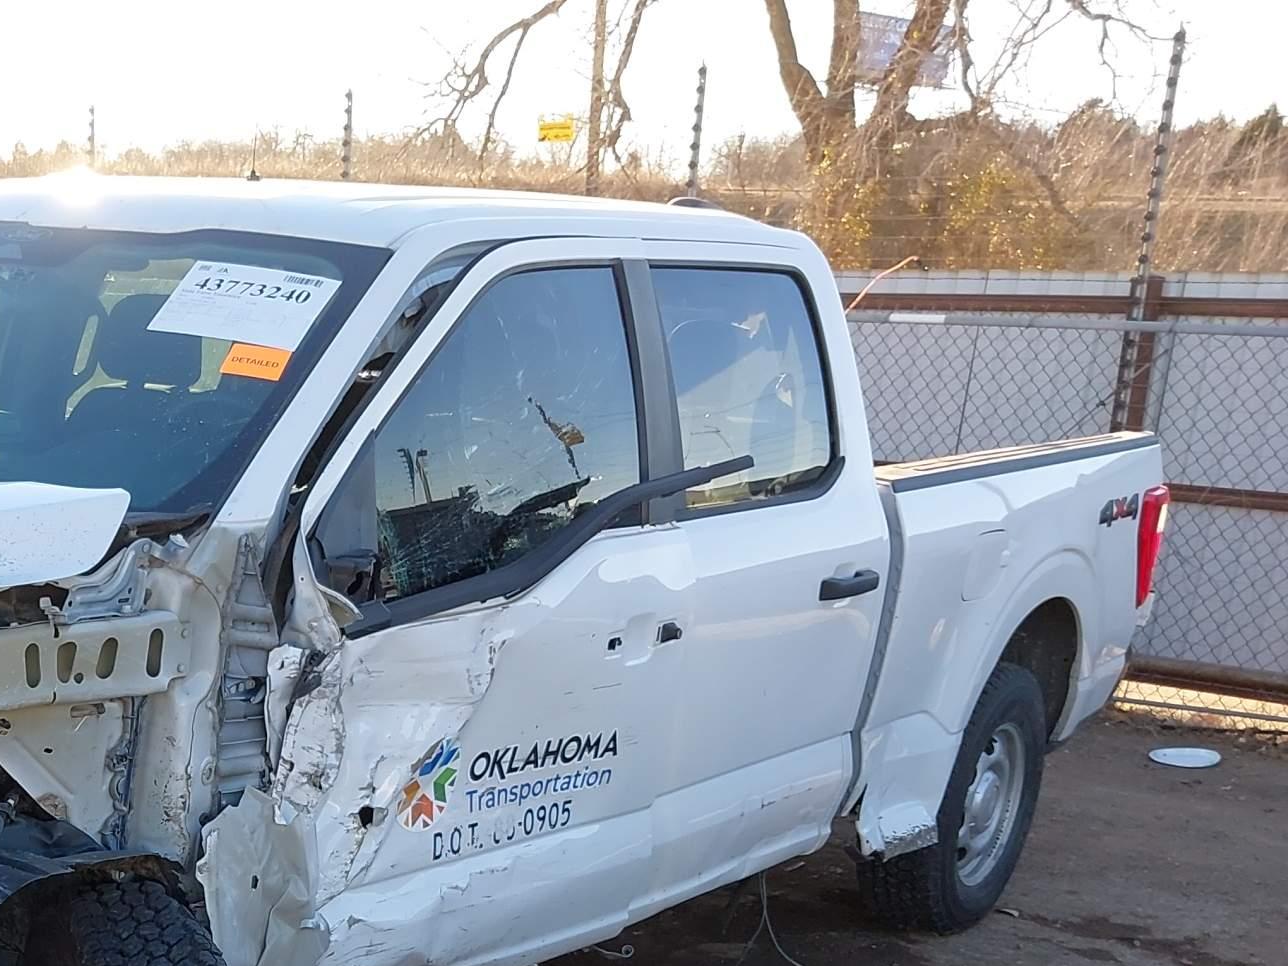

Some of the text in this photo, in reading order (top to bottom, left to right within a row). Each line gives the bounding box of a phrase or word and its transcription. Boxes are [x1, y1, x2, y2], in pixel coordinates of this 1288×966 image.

[195, 276, 312, 304] 43773240
[231, 356, 279, 368] DETAILED
[469, 730, 618, 782] OKLAHOMA
[467, 766, 612, 813] Transportation
